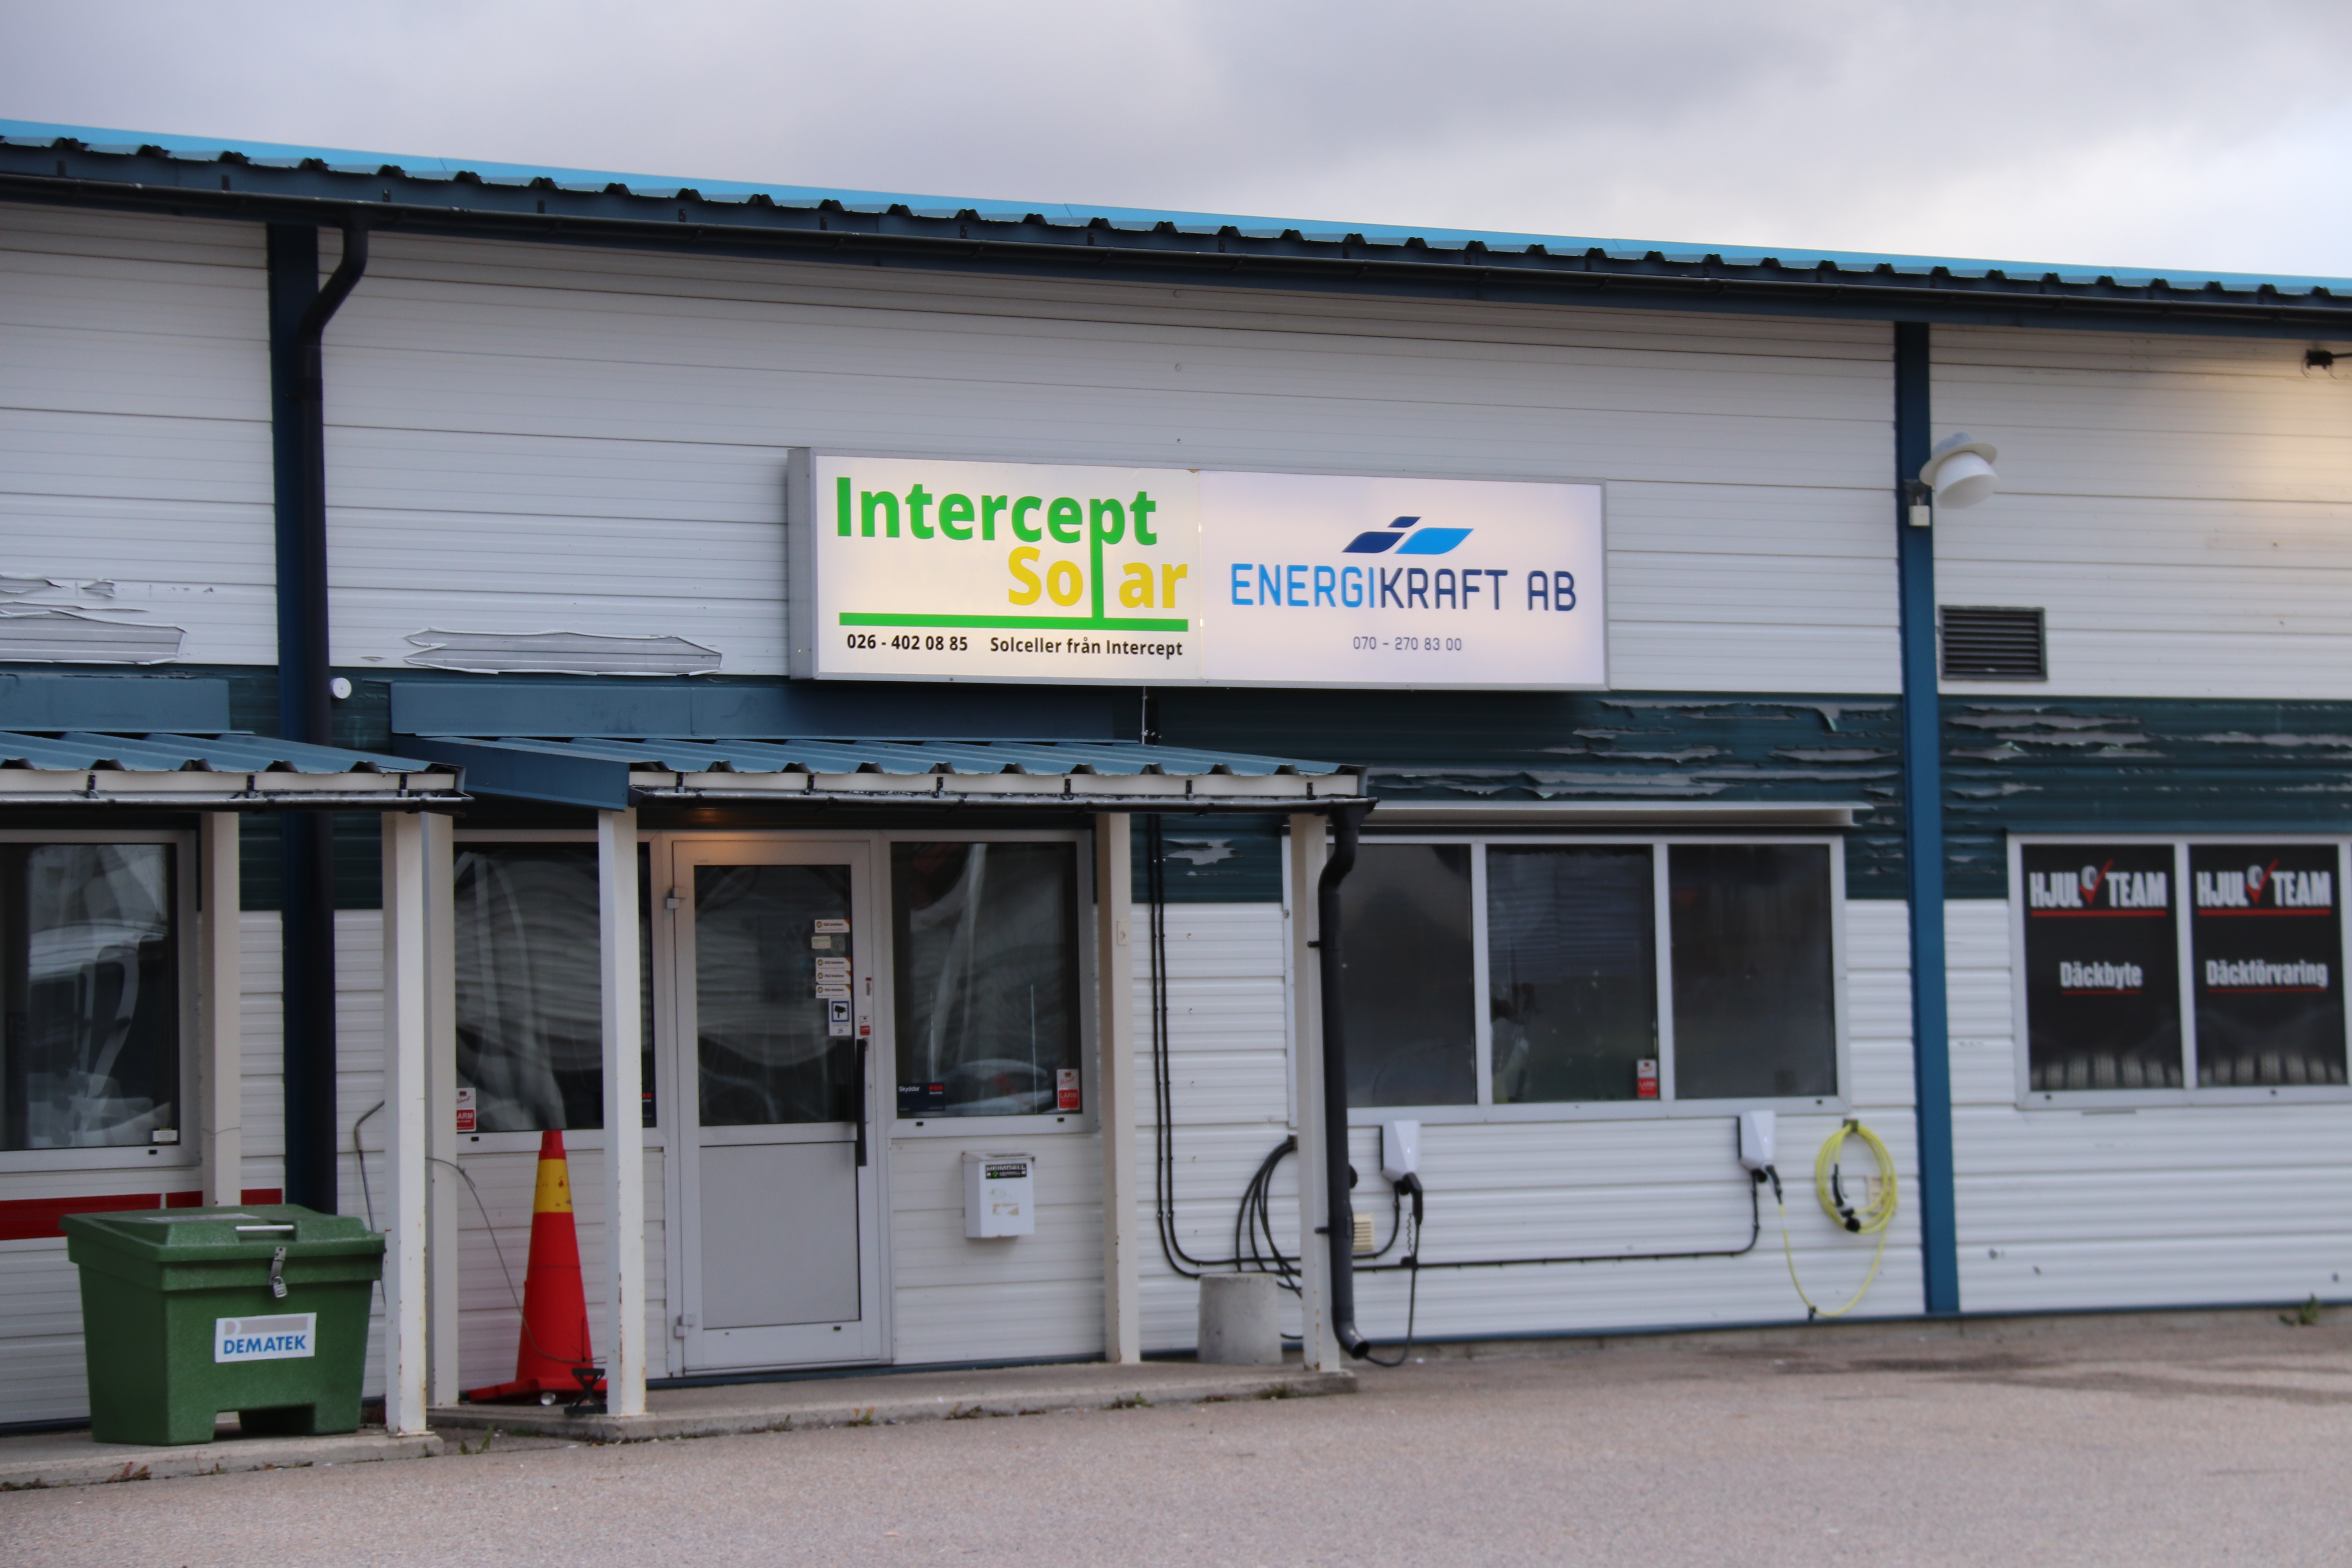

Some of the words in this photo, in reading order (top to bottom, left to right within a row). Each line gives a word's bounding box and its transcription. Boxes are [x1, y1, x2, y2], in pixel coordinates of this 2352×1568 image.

[837, 477, 1158, 548] Intercept
[1230, 563, 1508, 610] ENERGIKRAFT
[1528, 570, 1576, 612] AB
[847, 633, 877, 650] 026
[891, 635, 920, 650] 402
[925, 635, 944, 651] 08
[949, 636, 968, 652] 85
[990, 636, 1062, 654] Solceller
[1066, 637, 1101, 654] från
[1106, 639, 1183, 660] Intercept
[1353, 636, 1377, 650] 070
[1395, 636, 1419, 651] 270
[1424, 637, 1440, 651] 83
[1446, 637, 1462, 652] 00
[2029, 872, 2082, 908] HJUL
[2105, 872, 2167, 907] TEAM
[2196, 871, 2248, 907] HJUL
[2270, 871, 2332, 907] TEAM
[2060, 961, 2143, 990] Däckbyte
[2206, 959, 2328, 988] Däckförvaring
[224, 1334, 307, 1355] DEMATEK
